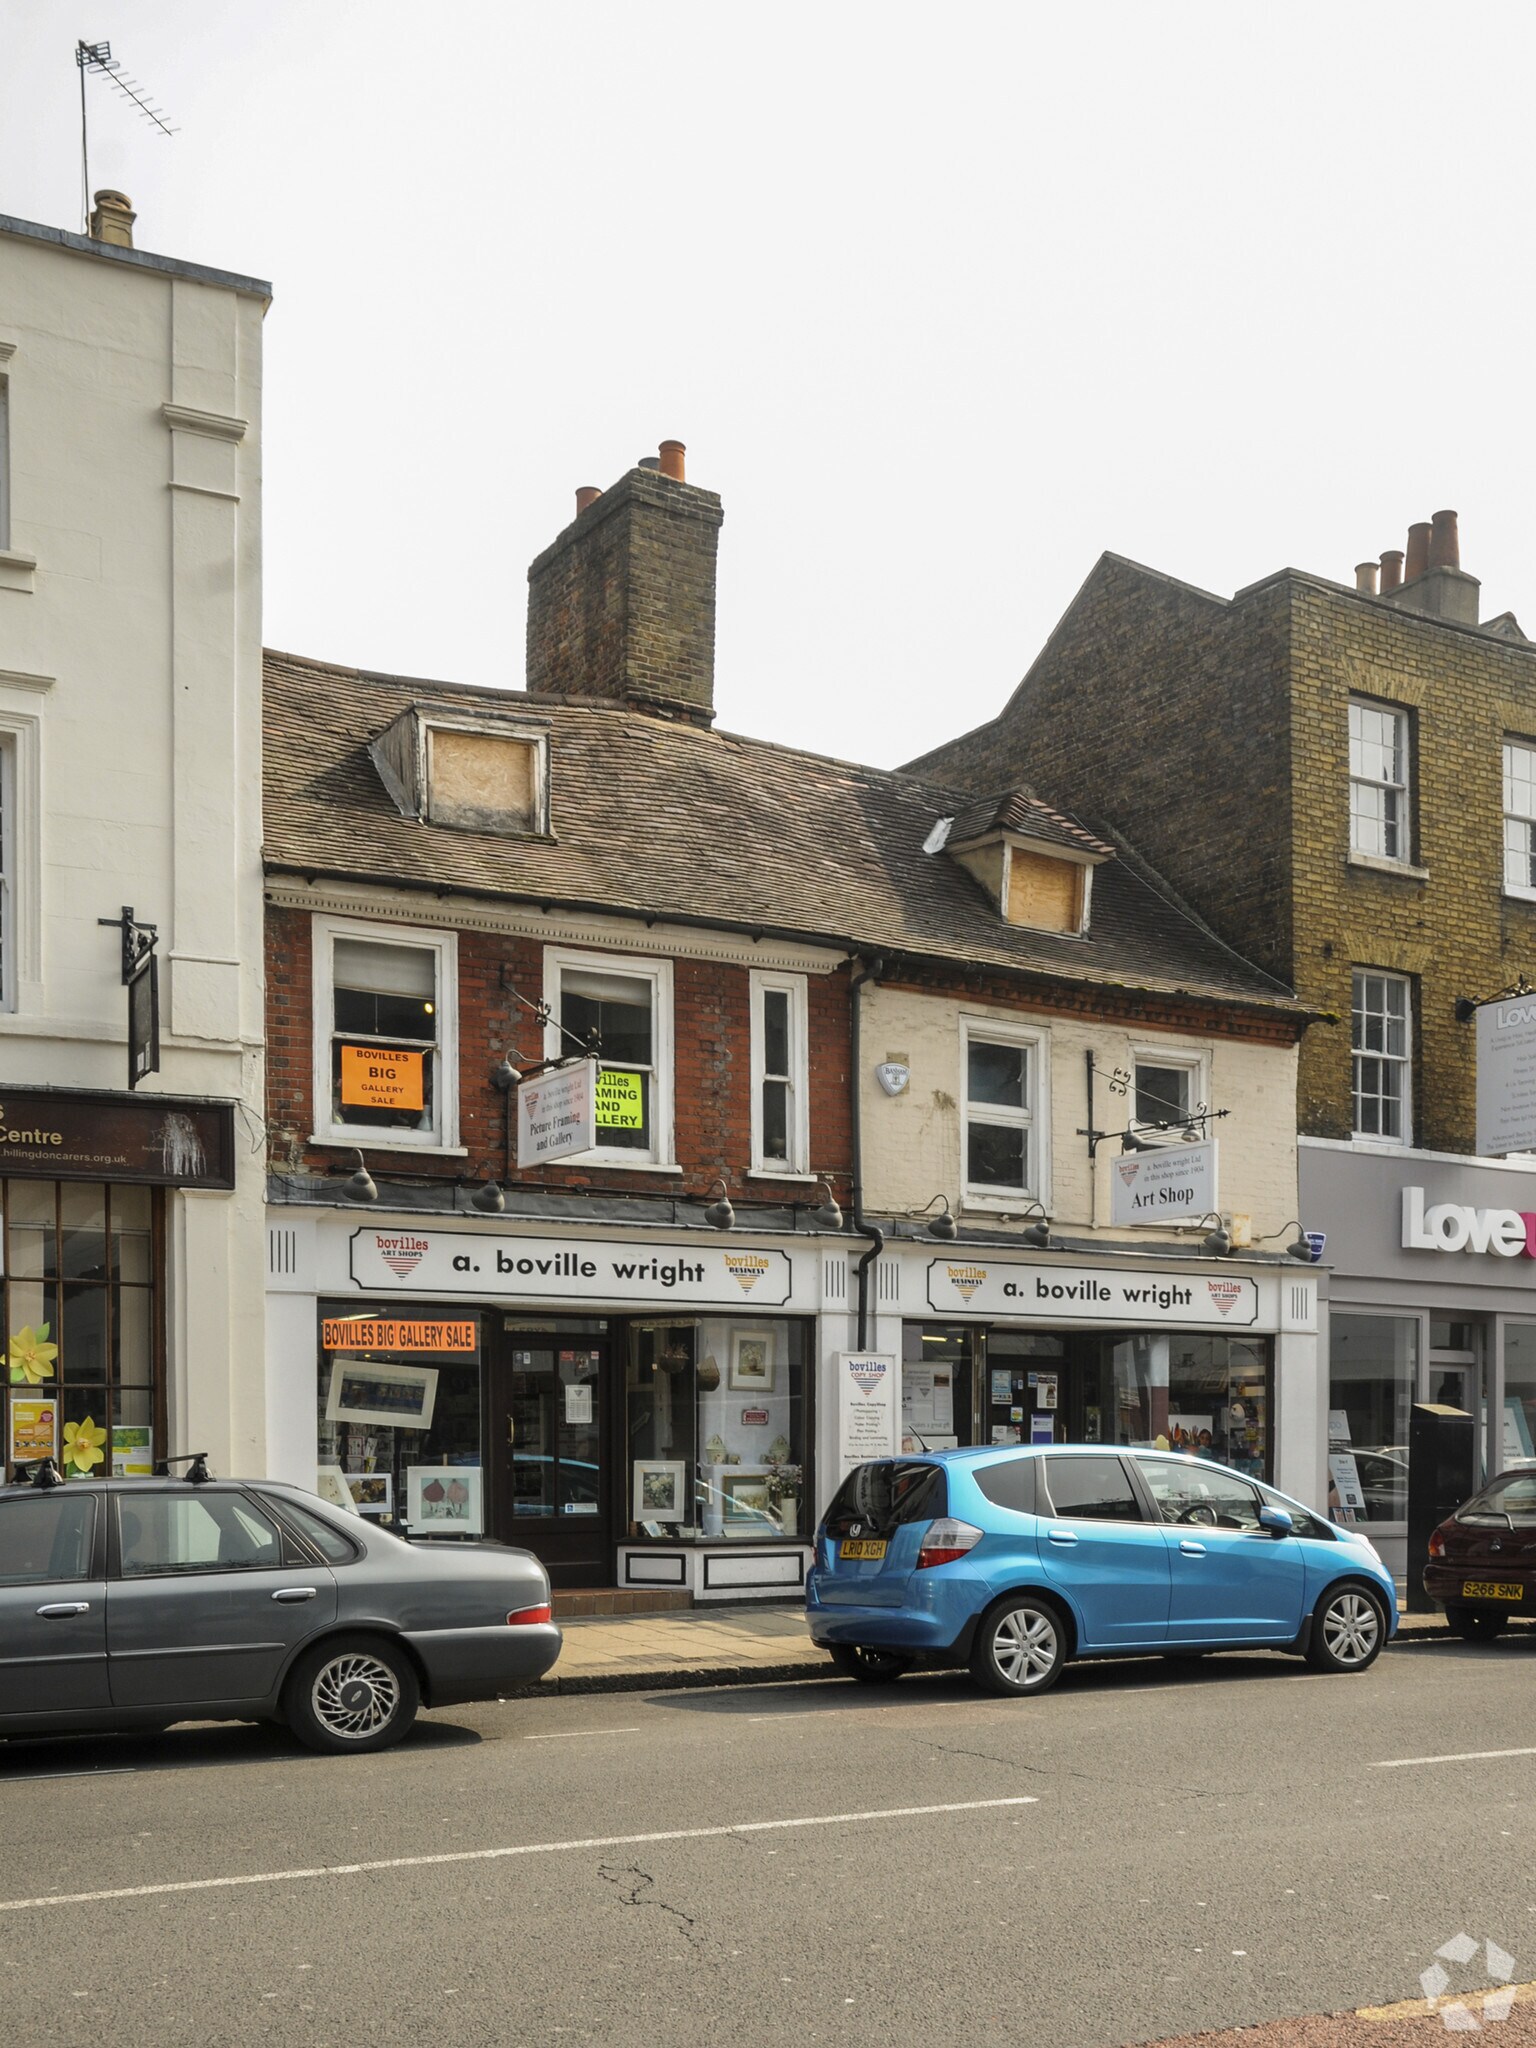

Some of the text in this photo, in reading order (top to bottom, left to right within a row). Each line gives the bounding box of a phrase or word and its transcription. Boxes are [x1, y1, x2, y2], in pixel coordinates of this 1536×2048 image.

[356, 1050, 409, 1062] BOVILLES
[369, 1067, 396, 1079] BIG
[361, 1084, 404, 1093] GALLERY
[371, 1096, 395, 1105] SALE
[530, 1111, 580, 1136] Picture Framing
[536, 1132, 573, 1151] and Gallery
[1173, 1157, 1190, 1167] wright
[1161, 1171, 1174, 1180] shop
[1131, 1187, 1194, 1209] Art Shop
[376, 1236, 428, 1250] bovilles
[452, 1249, 705, 1287] a. boville wright
[724, 1254, 769, 1268] bovilles
[729, 1266, 765, 1274] BUSINESS
[947, 1264, 987, 1279] bovilles
[1003, 1277, 1192, 1309] a. boville wright
[1208, 1281, 1242, 1293] bovilles
[325, 1323, 471, 1347] BOVILLES BIG GALLERY SALE
[849, 1361, 887, 1372] bovilles
[864, 1541, 884, 1556] XGH
[1464, 1582, 1522, 1598] S266 SNK
